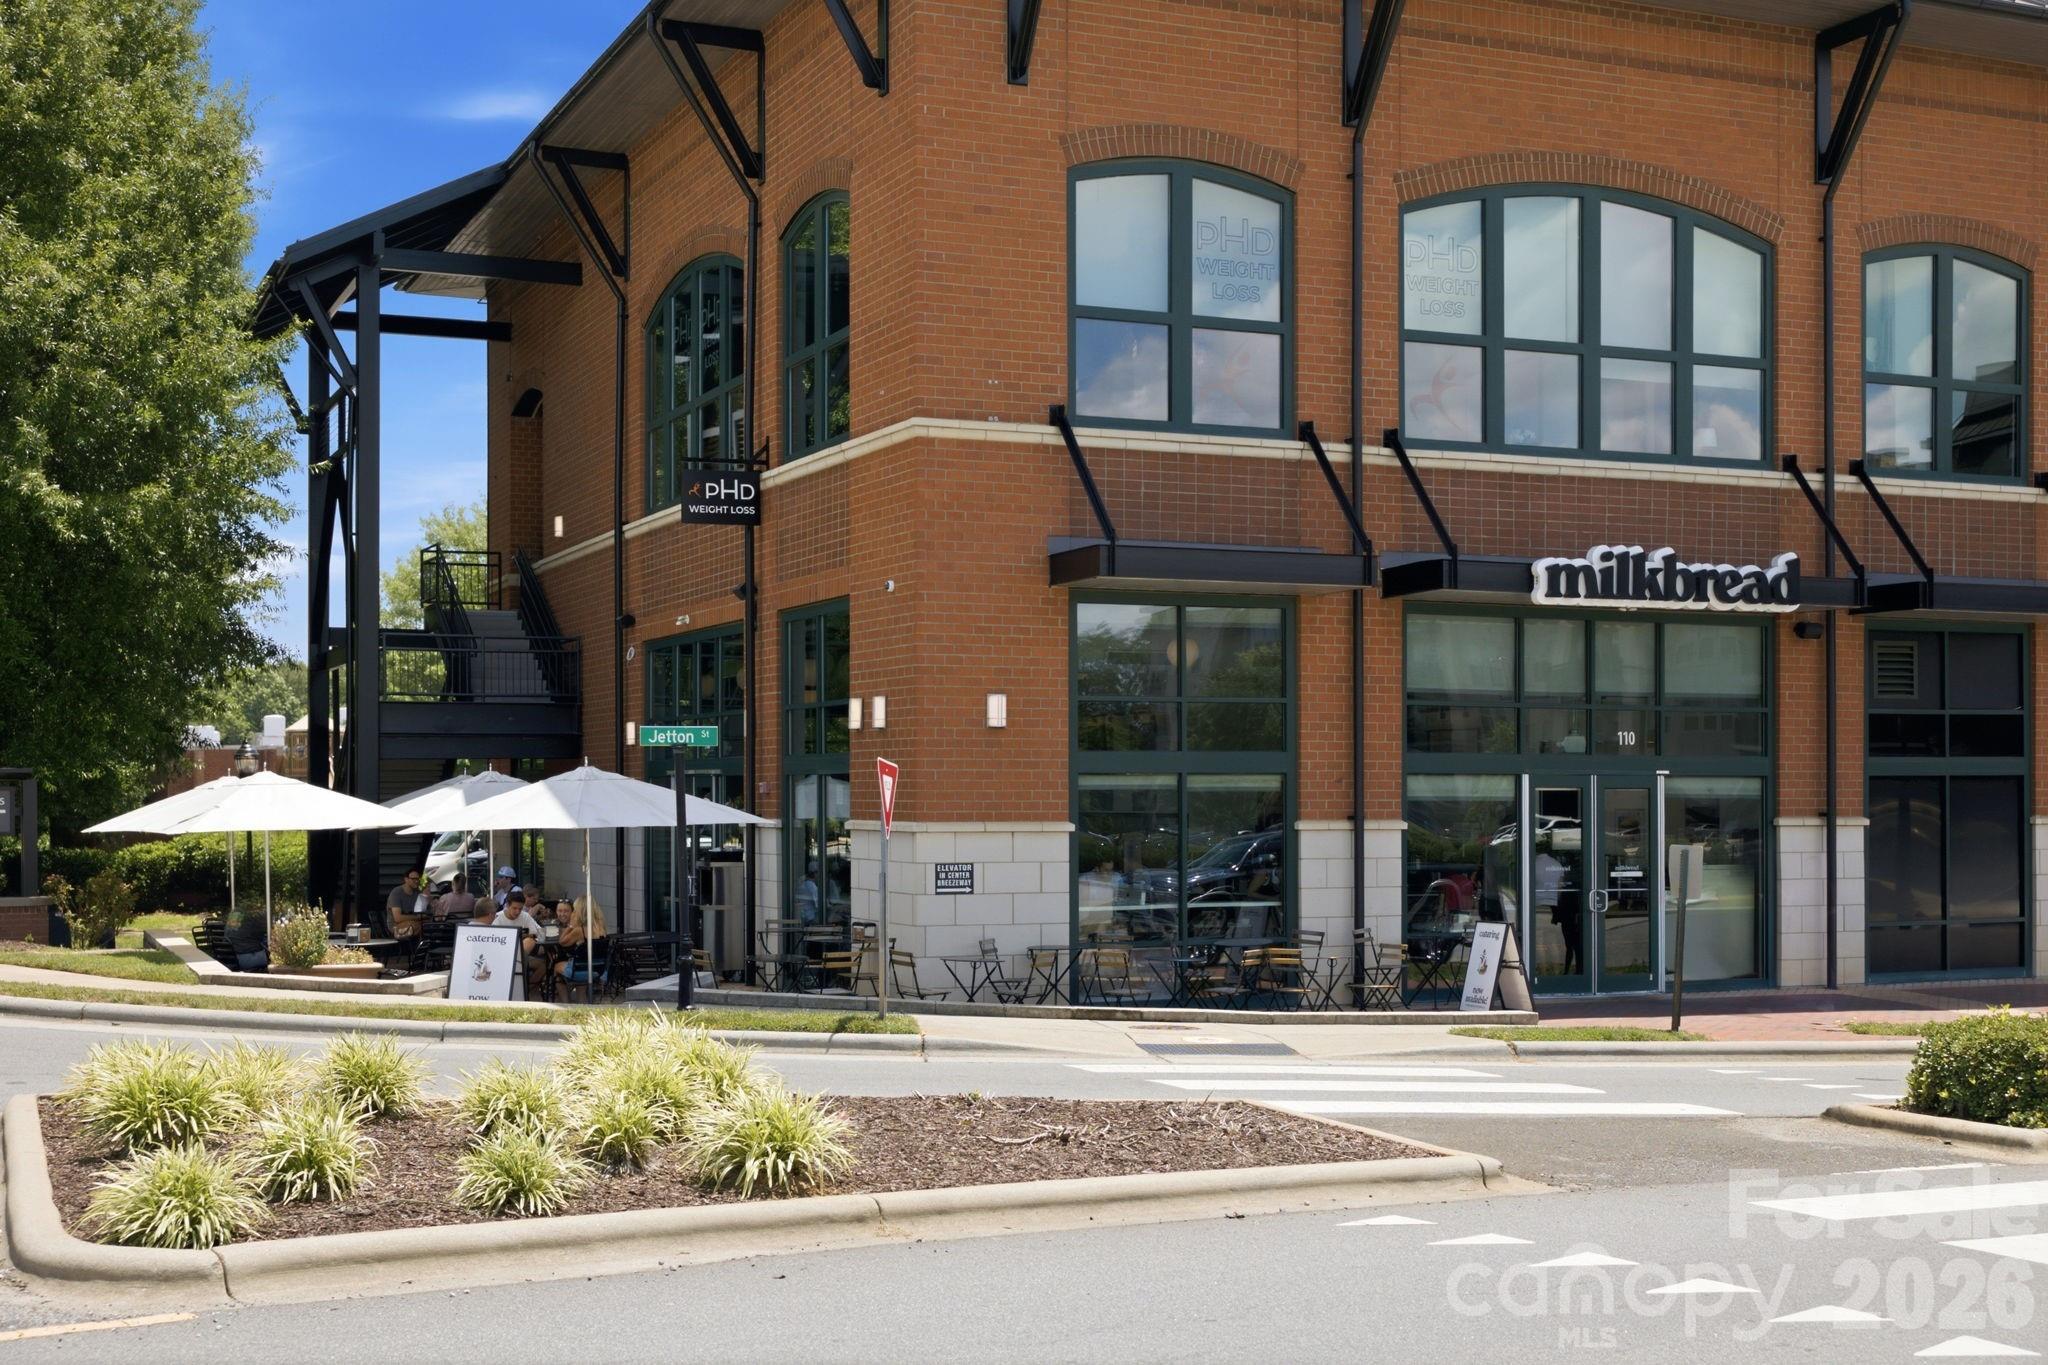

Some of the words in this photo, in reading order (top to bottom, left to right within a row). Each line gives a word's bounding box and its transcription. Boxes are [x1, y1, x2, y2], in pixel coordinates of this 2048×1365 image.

[1196, 216, 1275, 256] PHD
[1406, 234, 1479, 274] PHD
[1196, 256, 1276, 281] WEIGHT
[1211, 282, 1261, 303] LOSS
[1405, 273, 1480, 297] WEIGHT
[1420, 298, 1467, 318] LOSS
[705, 478, 756, 500] PHD
[688, 504, 729, 514] WEIGHT
[730, 506, 756, 515] LOSS
[1543, 549, 1800, 607] milkbread
[648, 729, 695, 743] Jetton
[701, 730, 710, 738] St
[1617, 731, 1636, 745] 110
[937, 864, 972, 872] ELEVATOR
[937, 879, 972, 887] BREEZEWAY
[466, 934, 508, 945] catering
[1479, 930, 1500, 940] catering
